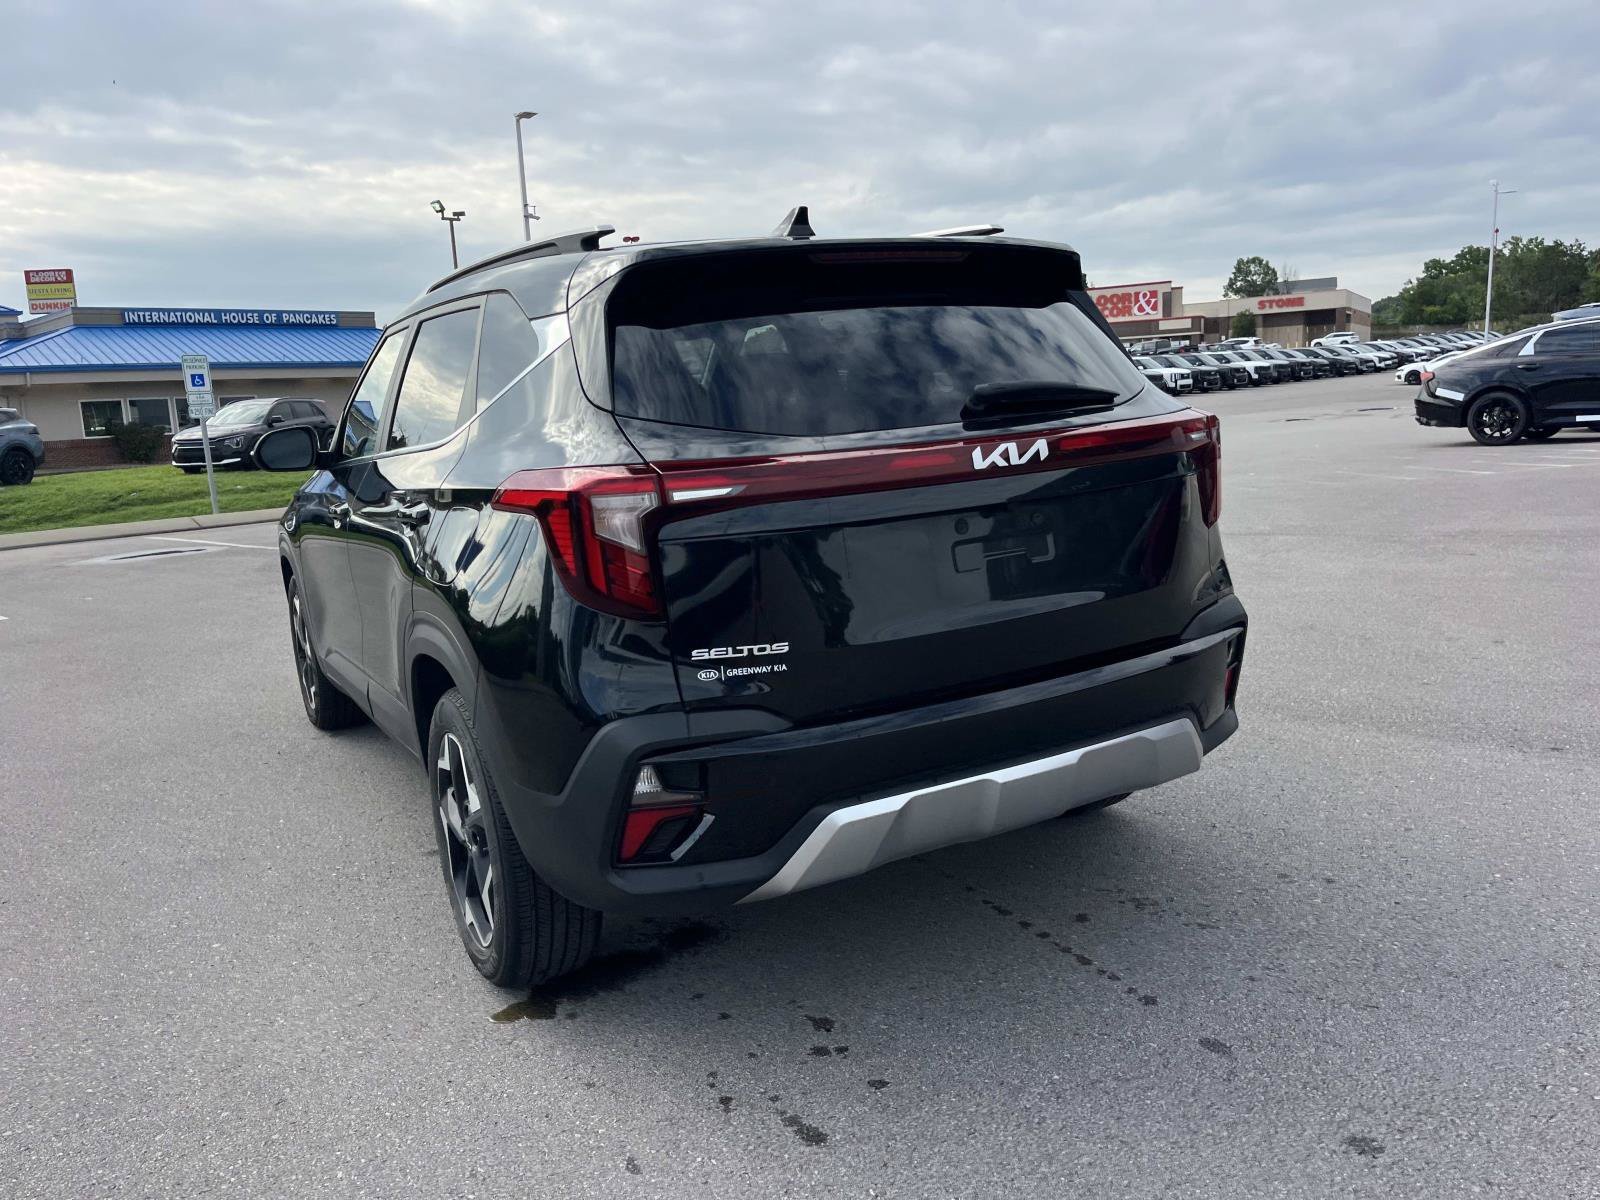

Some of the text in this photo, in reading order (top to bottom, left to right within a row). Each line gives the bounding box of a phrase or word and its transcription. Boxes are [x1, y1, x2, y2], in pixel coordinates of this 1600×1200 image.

[1257, 297, 1305, 310] STONE
[124, 311, 337, 325] INTERNATIONAL HOUSE OF PANCAKES
[972, 438, 1049, 470] KIA
[691, 641, 790, 660] SELTOS
[700, 663, 788, 679] KIA GREENWAY KIA
